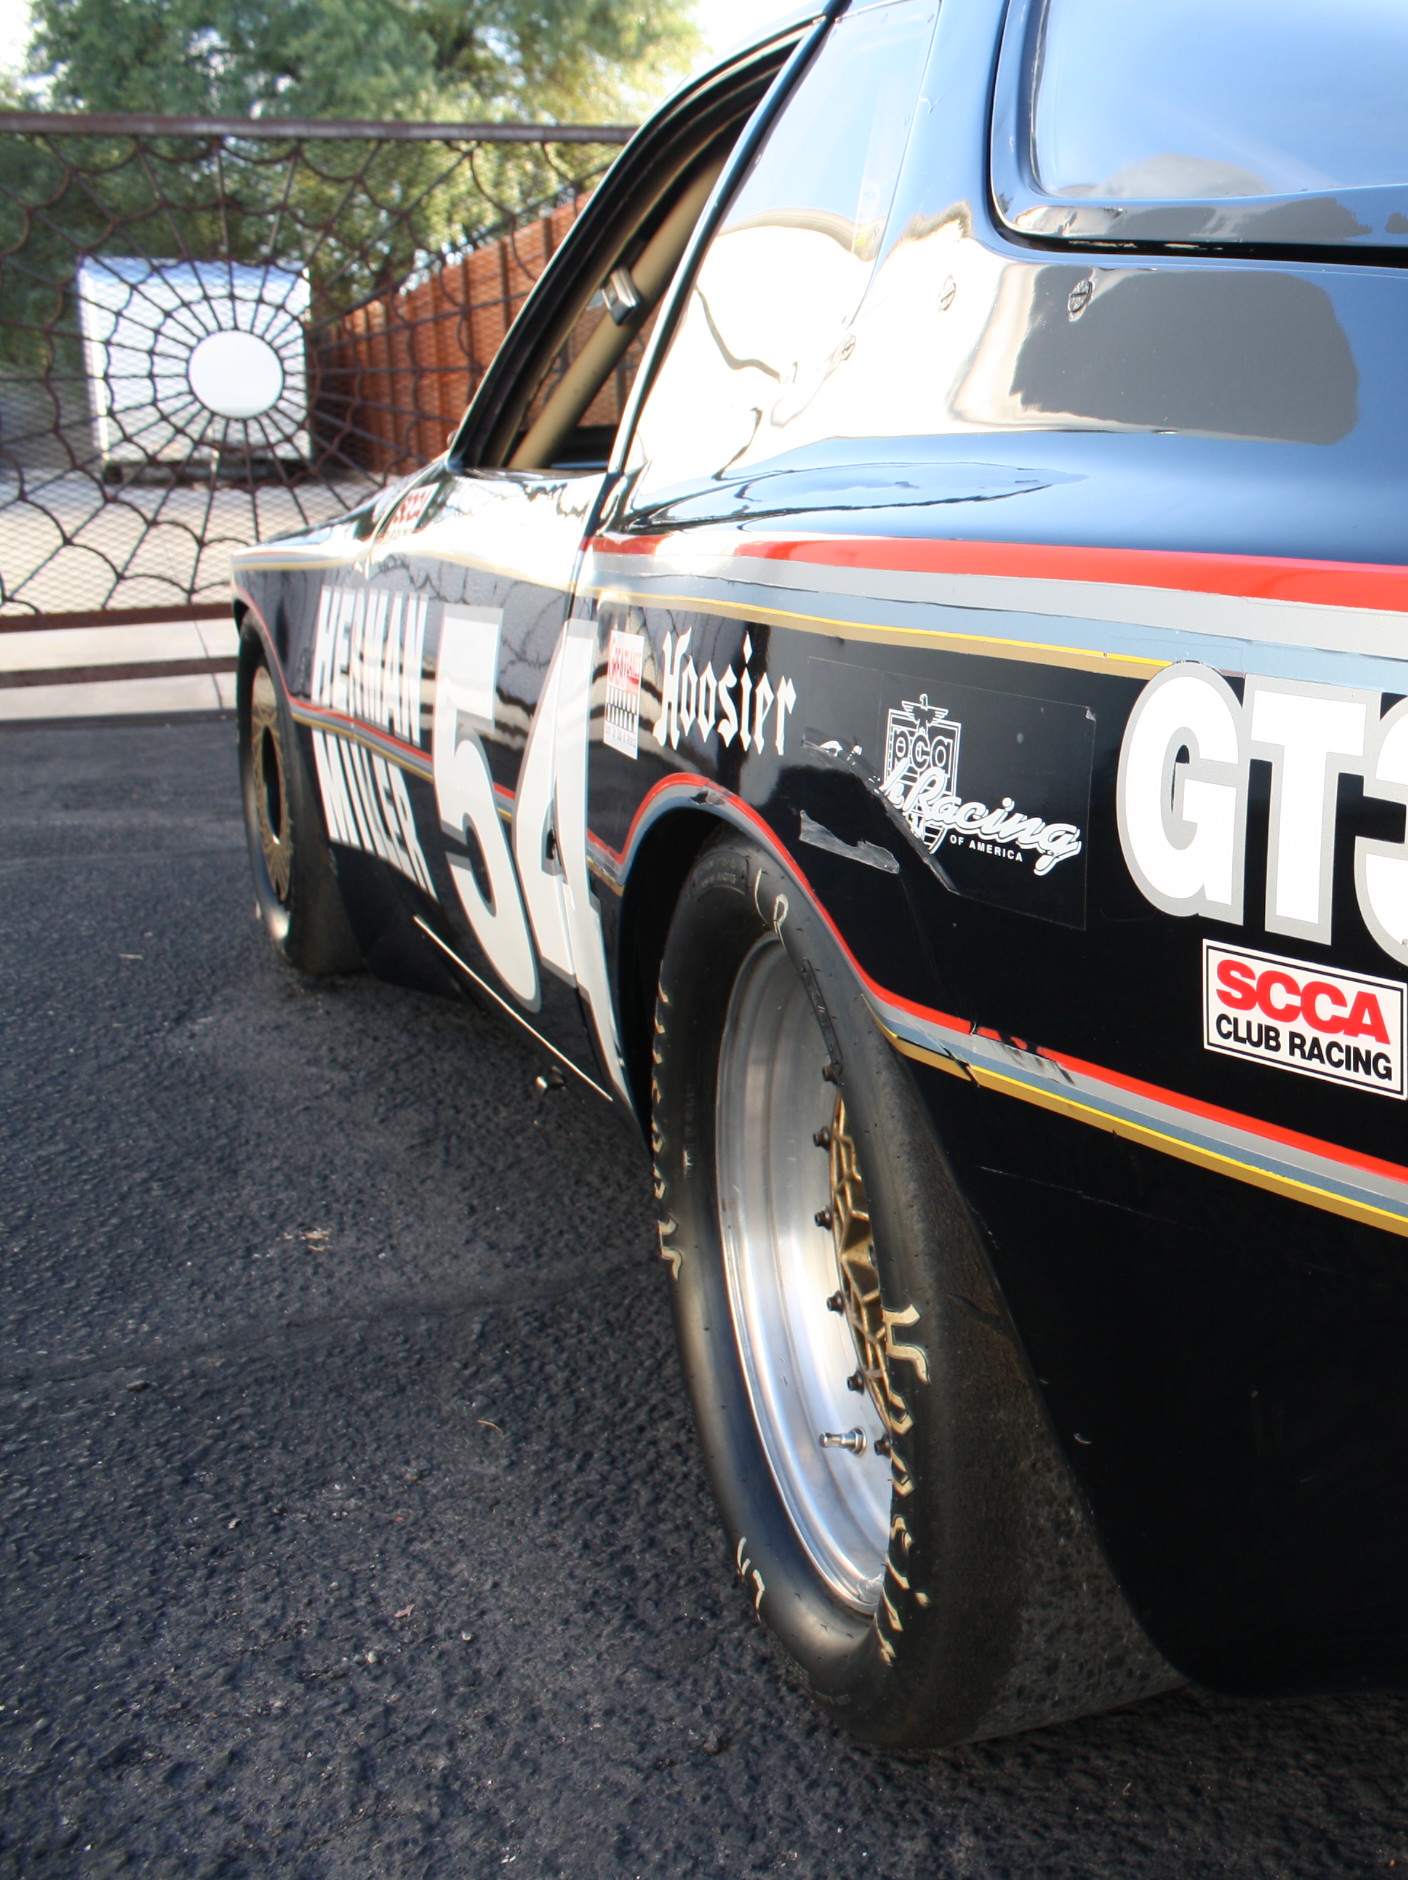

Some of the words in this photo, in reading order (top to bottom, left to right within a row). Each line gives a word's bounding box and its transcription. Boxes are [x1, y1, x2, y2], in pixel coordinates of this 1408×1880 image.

[312, 586, 429, 746] HERMAN
[652, 626, 797, 756] Hoosier
[312, 727, 440, 904] MILLER
[433, 603, 633, 1118] 54
[903, 767, 1082, 876] Racing
[949, 834, 965, 848] OF
[968, 840, 1024, 864] AMERICA
[1215, 1013, 1281, 1052] CLUB
[1289, 1031, 1393, 1081] RACING
[1216, 959, 1391, 1045] SCCA
